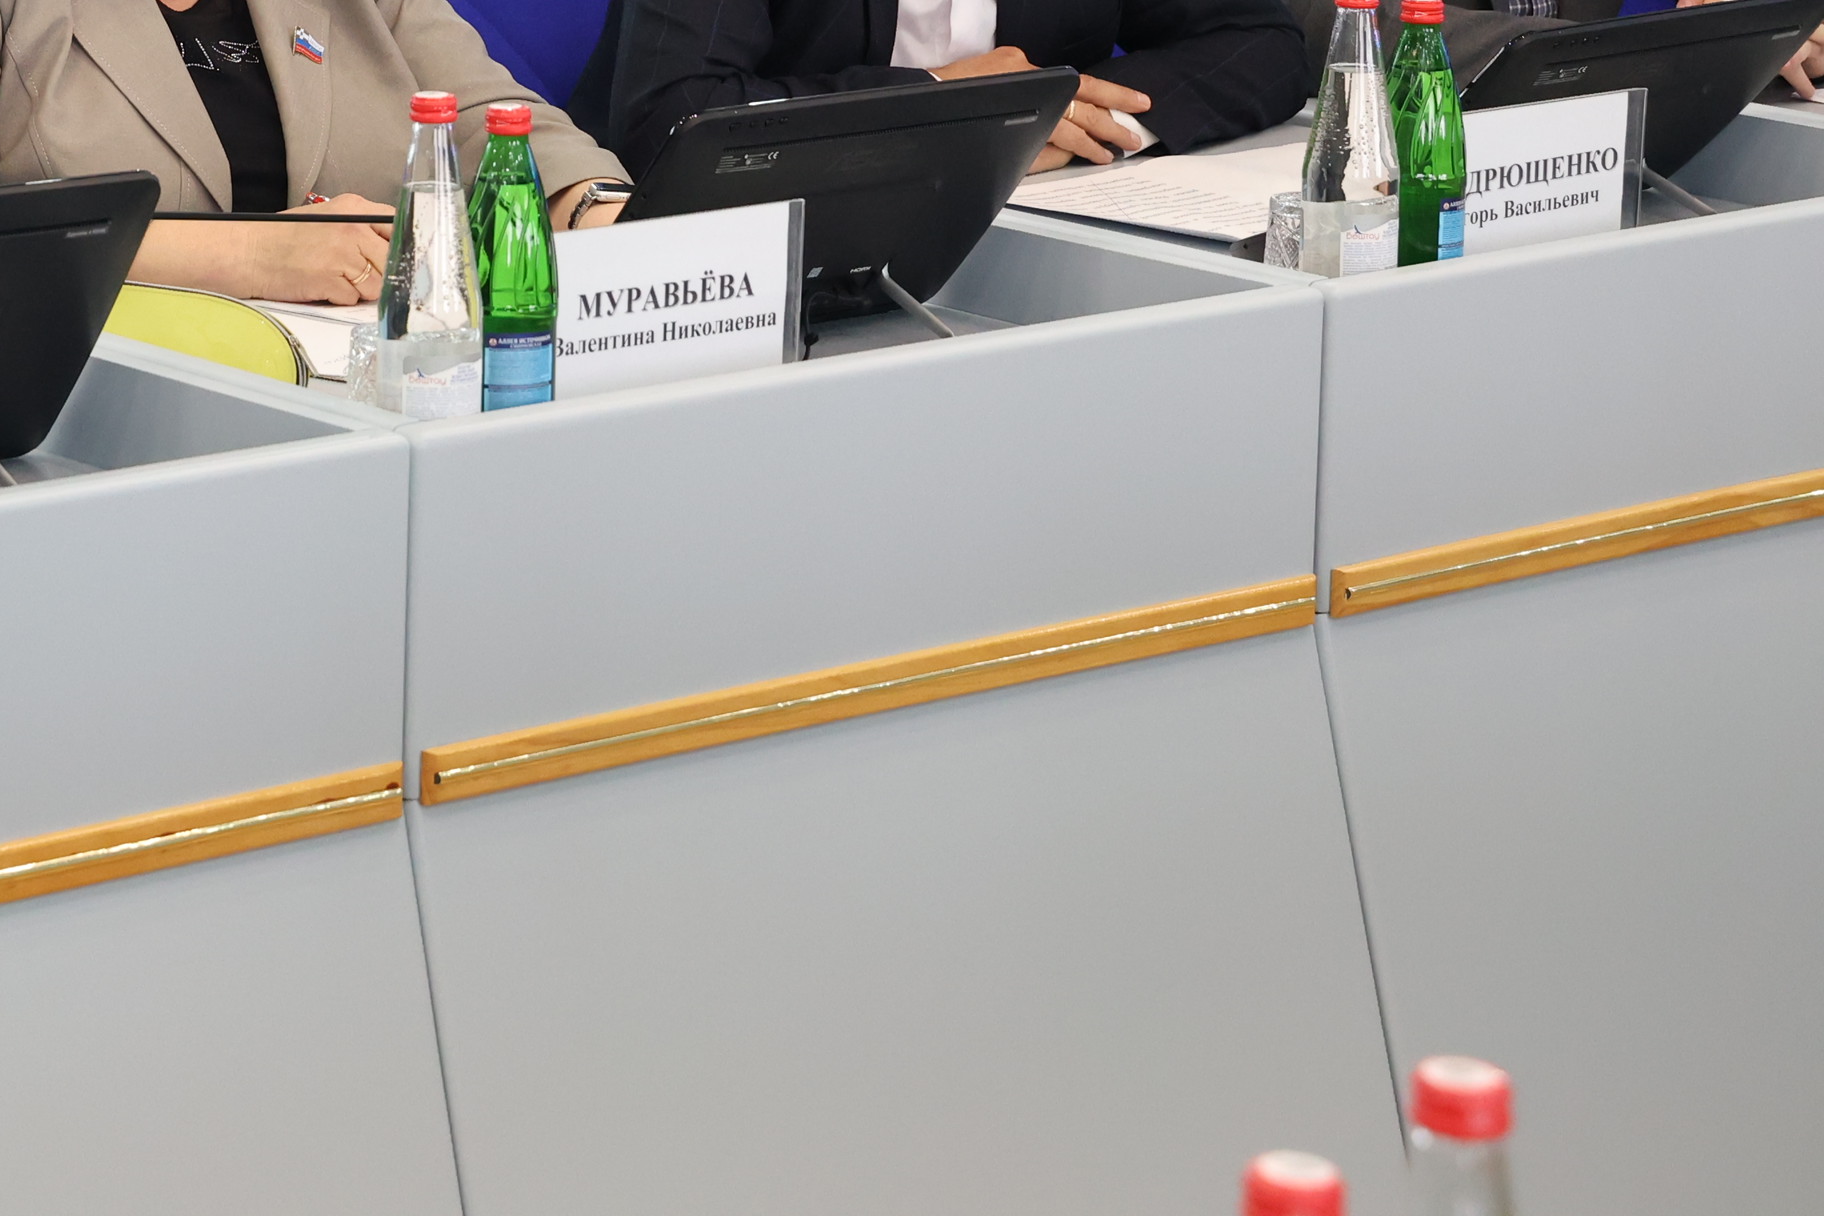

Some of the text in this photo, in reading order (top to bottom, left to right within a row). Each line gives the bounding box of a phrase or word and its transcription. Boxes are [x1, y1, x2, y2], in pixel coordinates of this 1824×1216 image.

[1466, 147, 1618, 200] ДРЮЩЕНКО
[1504, 189, 1600, 219] Васильевич
[577, 270, 755, 321] МУРАВЬЁВА
[555, 311, 777, 358] Валентина Николаевна
